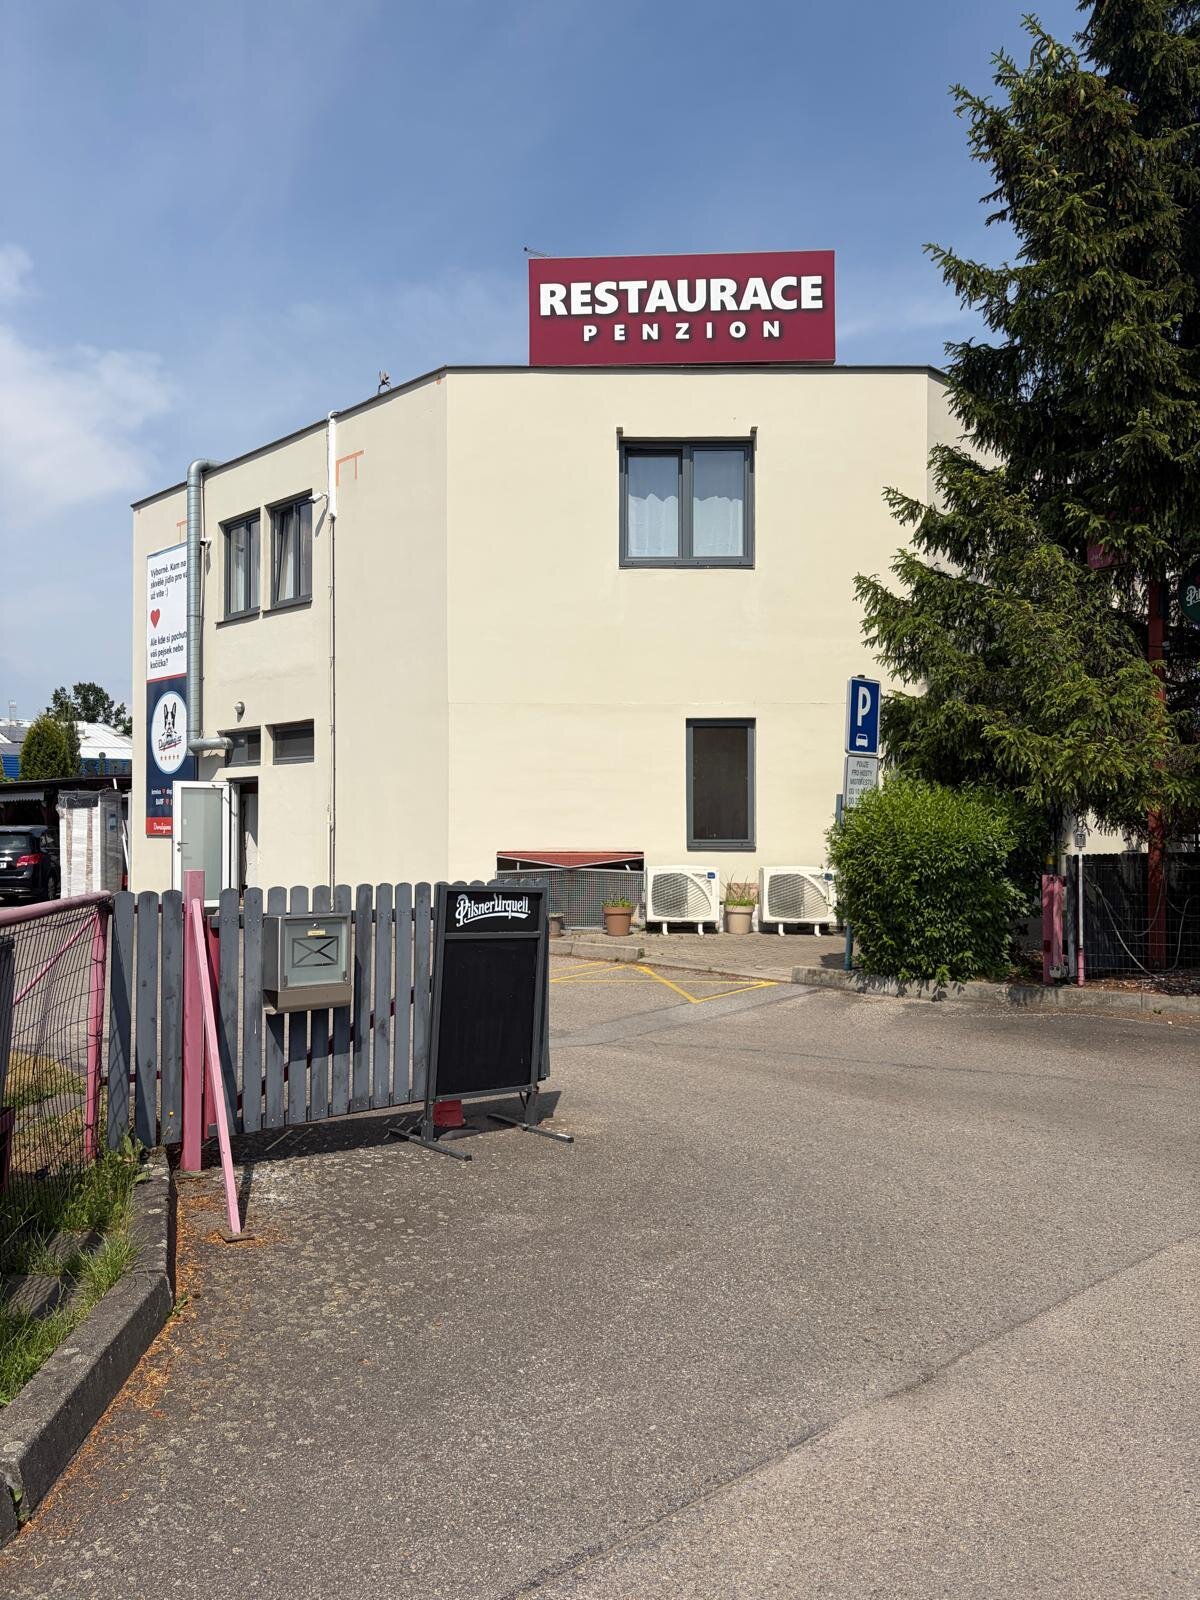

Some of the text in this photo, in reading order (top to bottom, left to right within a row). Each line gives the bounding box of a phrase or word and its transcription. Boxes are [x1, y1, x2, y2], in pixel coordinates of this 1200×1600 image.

[539, 275, 824, 317] RESTAURACE
[582, 320, 781, 342] PENZION
[150, 560, 187, 578] Výborné. Kam na
[150, 576, 164, 589] skvělé
[164, 574, 175, 587] jídlo
[151, 592, 156, 601] už
[156, 590, 164, 599] víte
[158, 635, 166, 644] kde
[166, 633, 171, 643] si
[158, 647, 172, 659] pejsek
[172, 644, 184, 653] nebo
[857, 686, 872, 727] P
[455, 894, 494, 928] Pilsner
